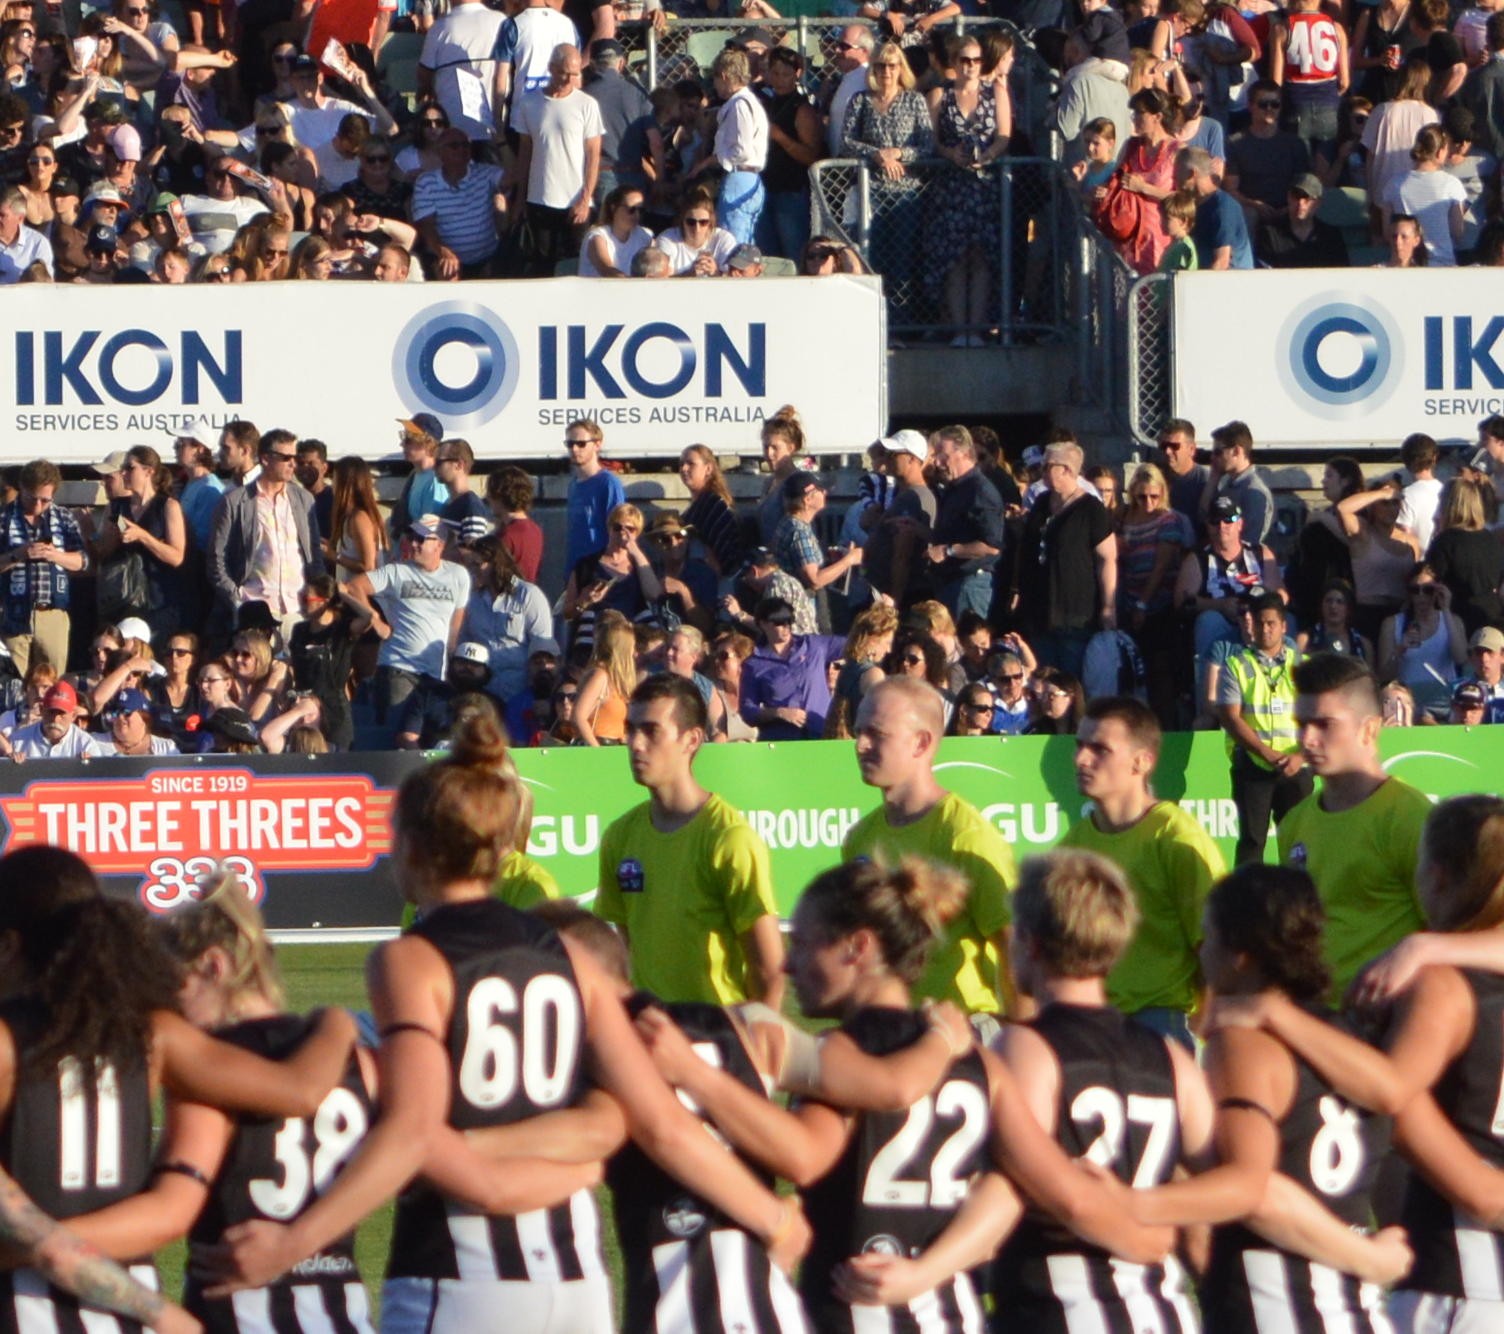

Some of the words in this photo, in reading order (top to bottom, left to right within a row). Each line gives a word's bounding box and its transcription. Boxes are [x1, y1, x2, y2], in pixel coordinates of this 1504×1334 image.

[1286, 20, 1339, 75] 46
[15, 328, 243, 406] IKON
[539, 322, 767, 399] IKON
[16, 414, 119, 431] SERVICES
[539, 408, 642, 426] SERVICES
[649, 406, 766, 424] AUSTRALIA
[151, 776, 203, 793] SINCE
[210, 775, 247, 792] 1919
[38, 801, 182, 853] THREE
[191, 797, 363, 850] THREES
[525, 814, 599, 857] GU
[980, 801, 1059, 844] GU
[459, 974, 580, 1110] 60
[58, 1057, 121, 1190] 11
[863, 1079, 989, 1208] 22
